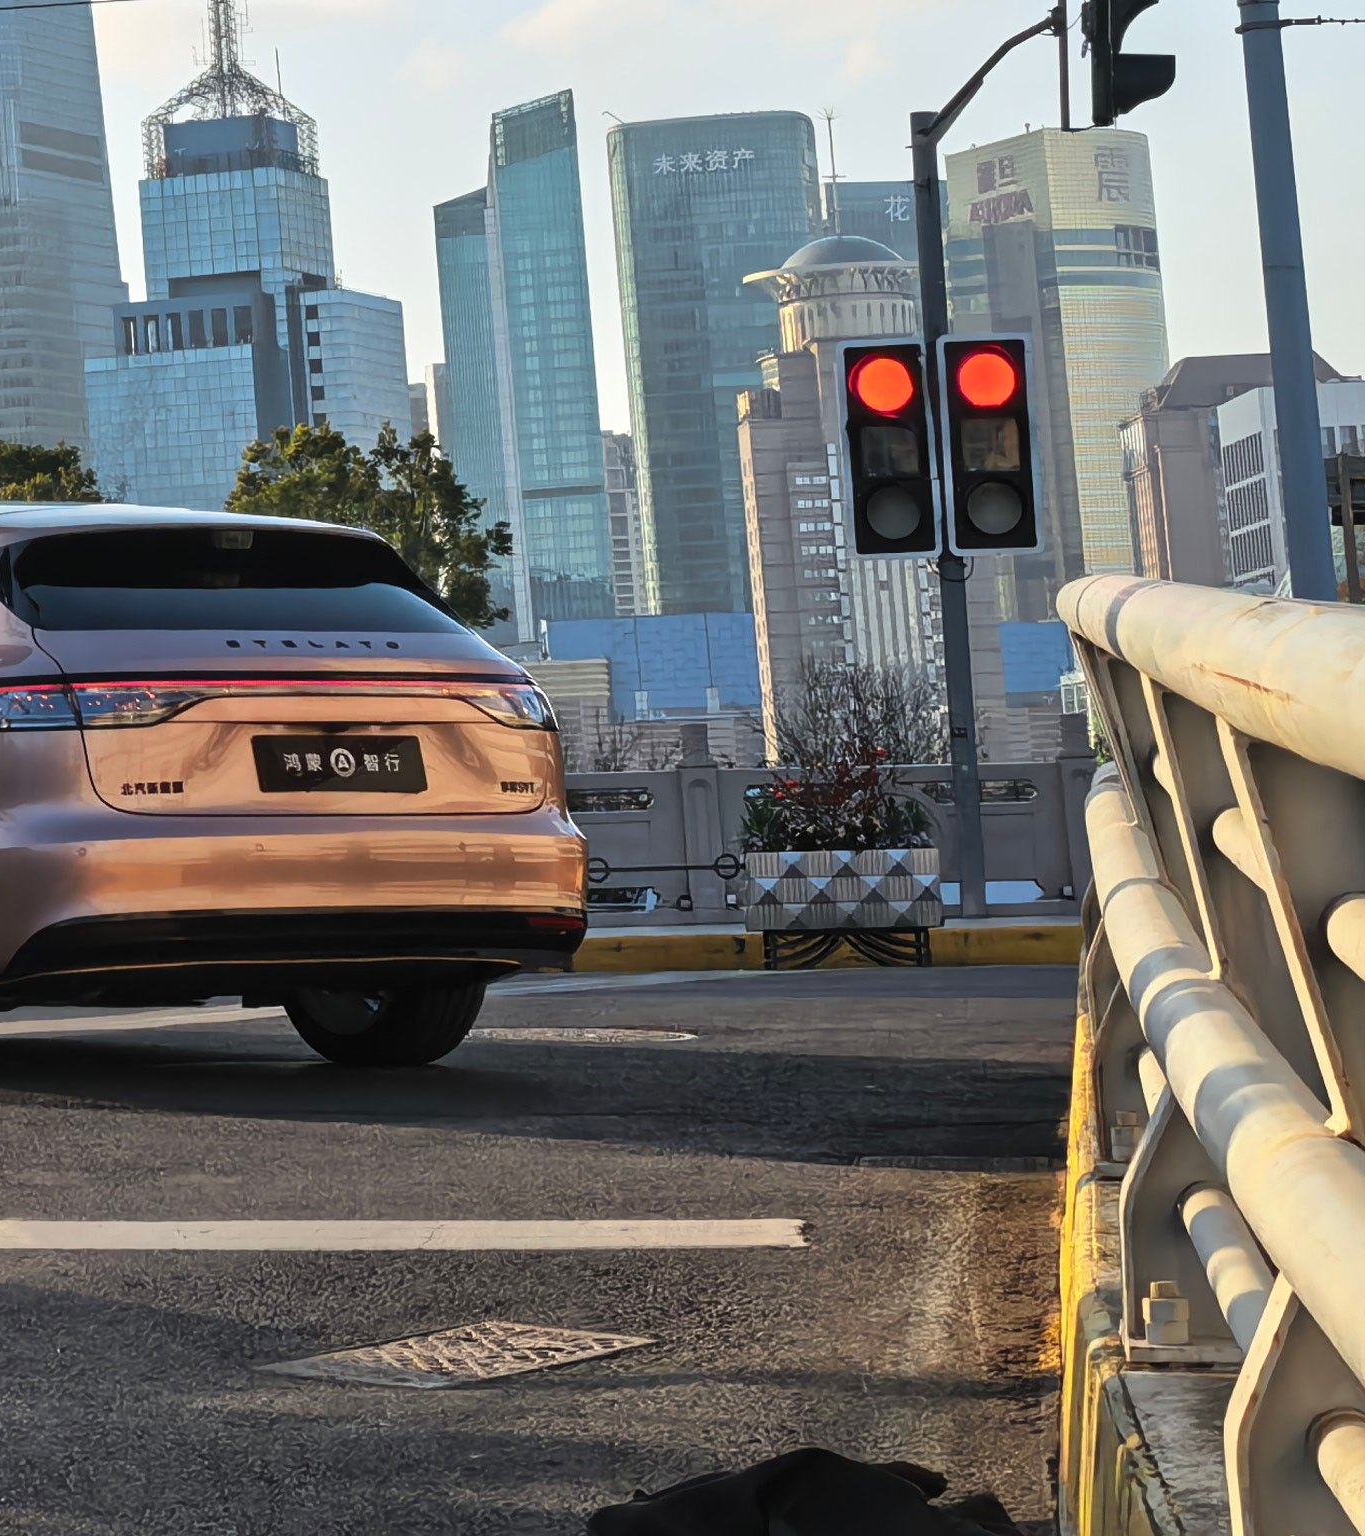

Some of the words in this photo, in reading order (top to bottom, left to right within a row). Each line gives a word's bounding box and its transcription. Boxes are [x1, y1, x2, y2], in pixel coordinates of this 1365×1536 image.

[652, 146, 755, 175] 未来资产
[363, 753, 400, 772] 智行
